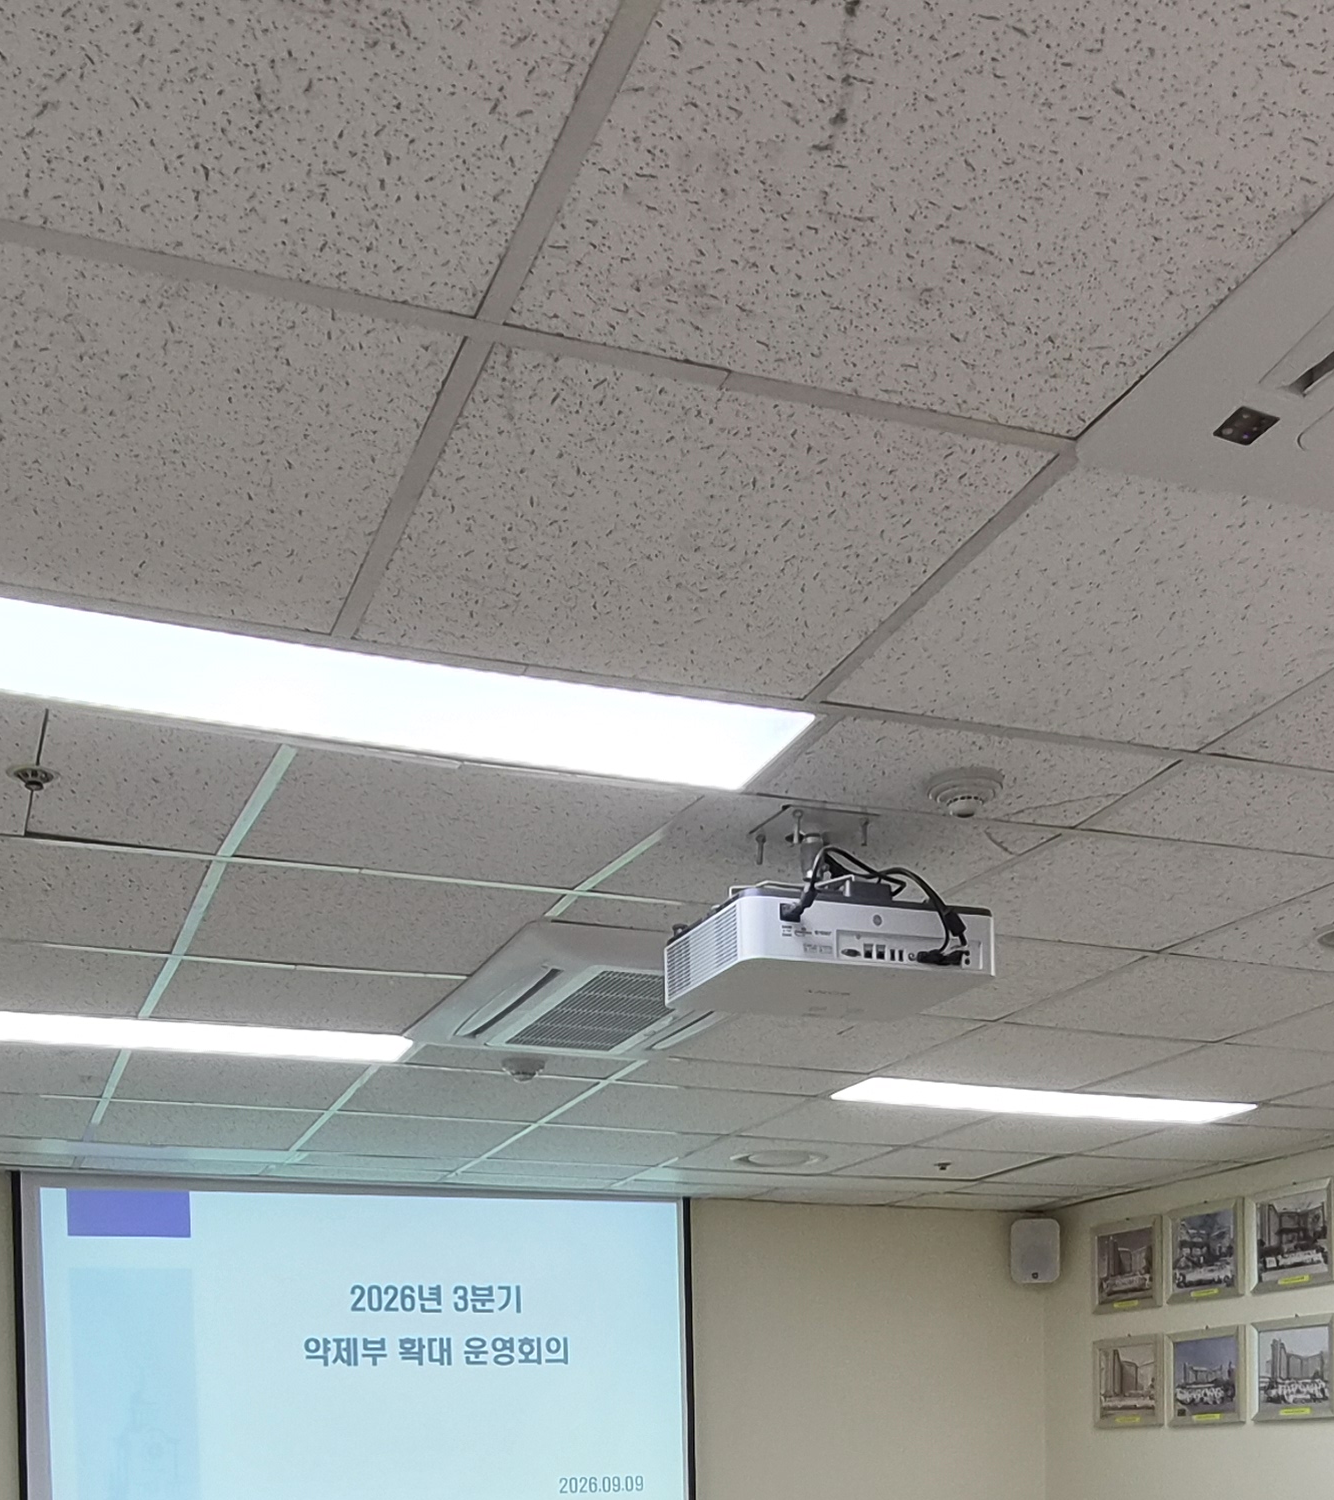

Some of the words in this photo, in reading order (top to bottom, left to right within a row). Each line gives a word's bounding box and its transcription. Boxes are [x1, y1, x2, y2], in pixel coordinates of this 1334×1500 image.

[349, 1283, 443, 1314] 2026년
[452, 1283, 522, 1314] 3분기
[303, 1336, 388, 1368] 약제부
[398, 1336, 453, 1367] 확대
[463, 1336, 569, 1366] 운영회의
[558, 1475, 644, 1494] 2026.09.09
